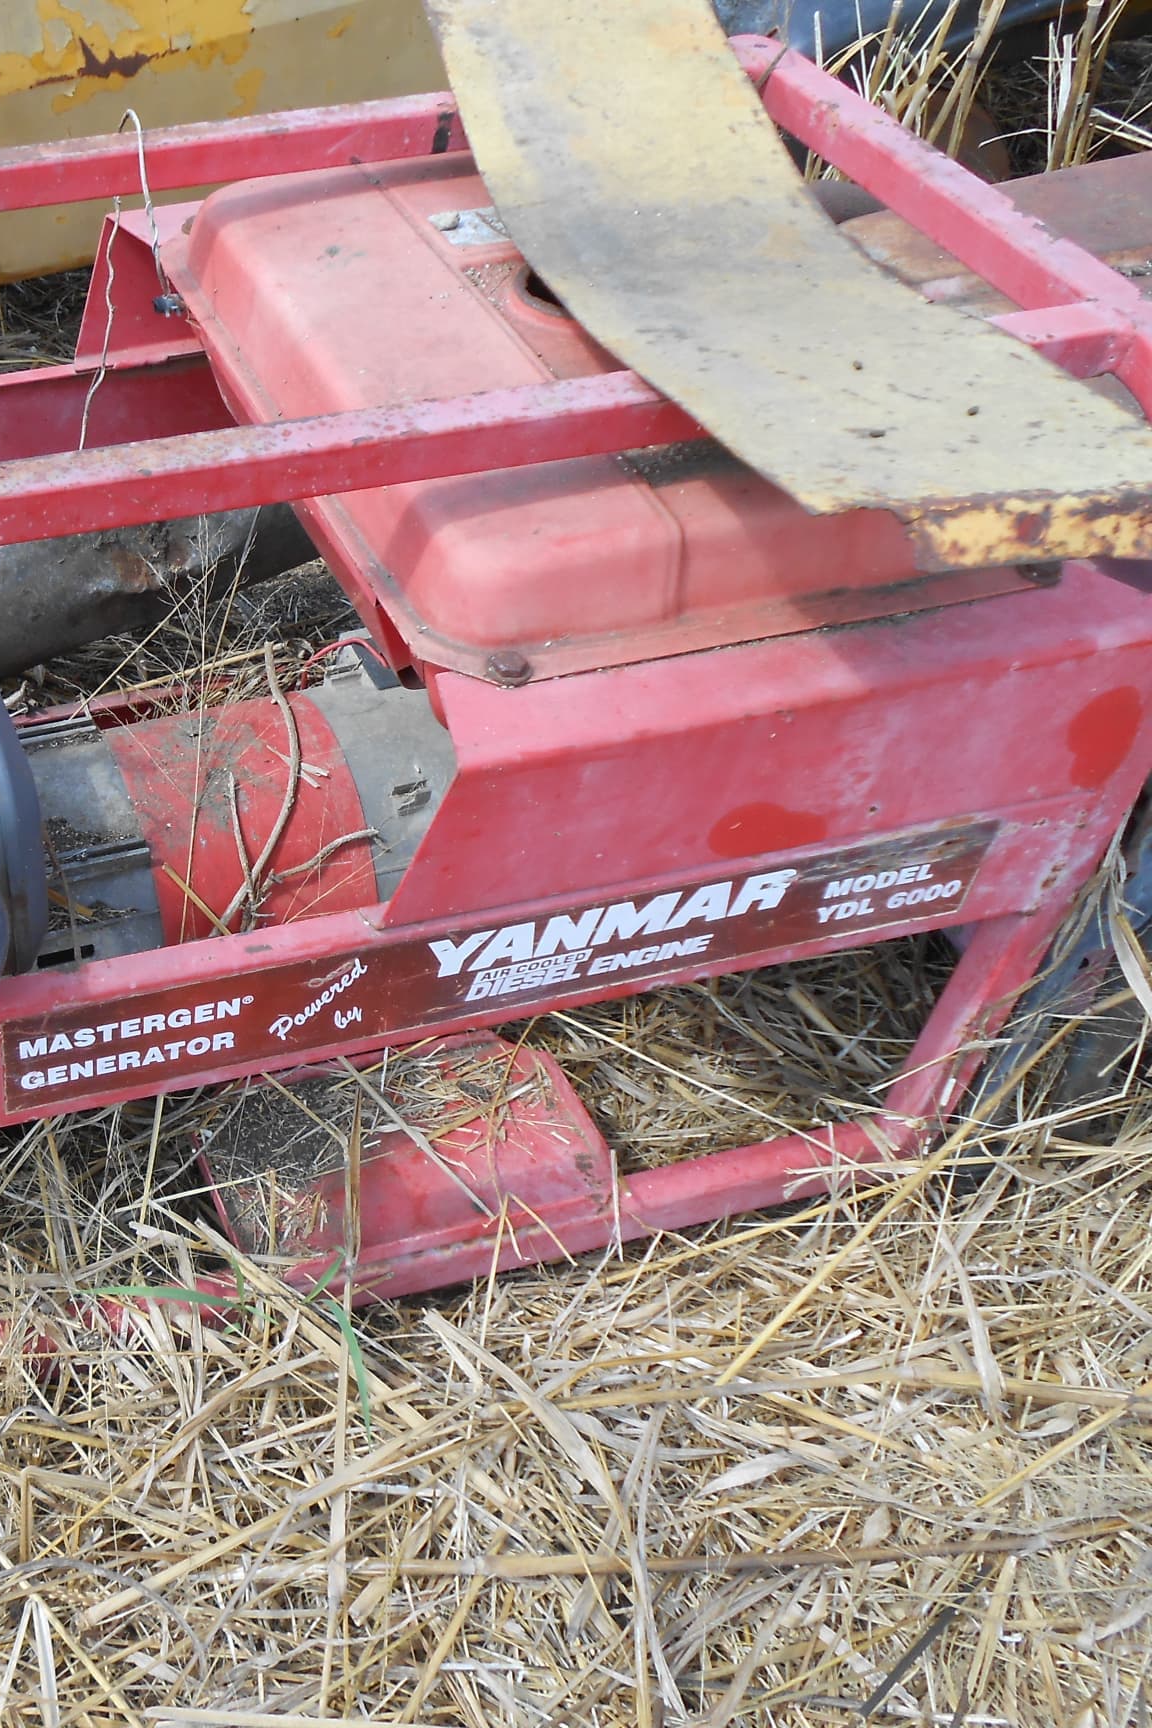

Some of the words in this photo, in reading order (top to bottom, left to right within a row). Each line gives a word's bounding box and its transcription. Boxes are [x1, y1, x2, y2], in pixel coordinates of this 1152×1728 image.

[816, 900, 874, 925] YDL
[887, 879, 963, 911] 6000
[823, 863, 935, 900] MODEL
[428, 868, 798, 979] YANMAR
[465, 965, 582, 1002] DIESEL
[590, 933, 715, 974] ENGINE
[480, 967, 512, 981] AIR
[515, 951, 589, 974] COOLED
[268, 957, 369, 1041] Powered
[333, 1006, 364, 1031] by
[20, 1031, 236, 1091] GENERATOR
